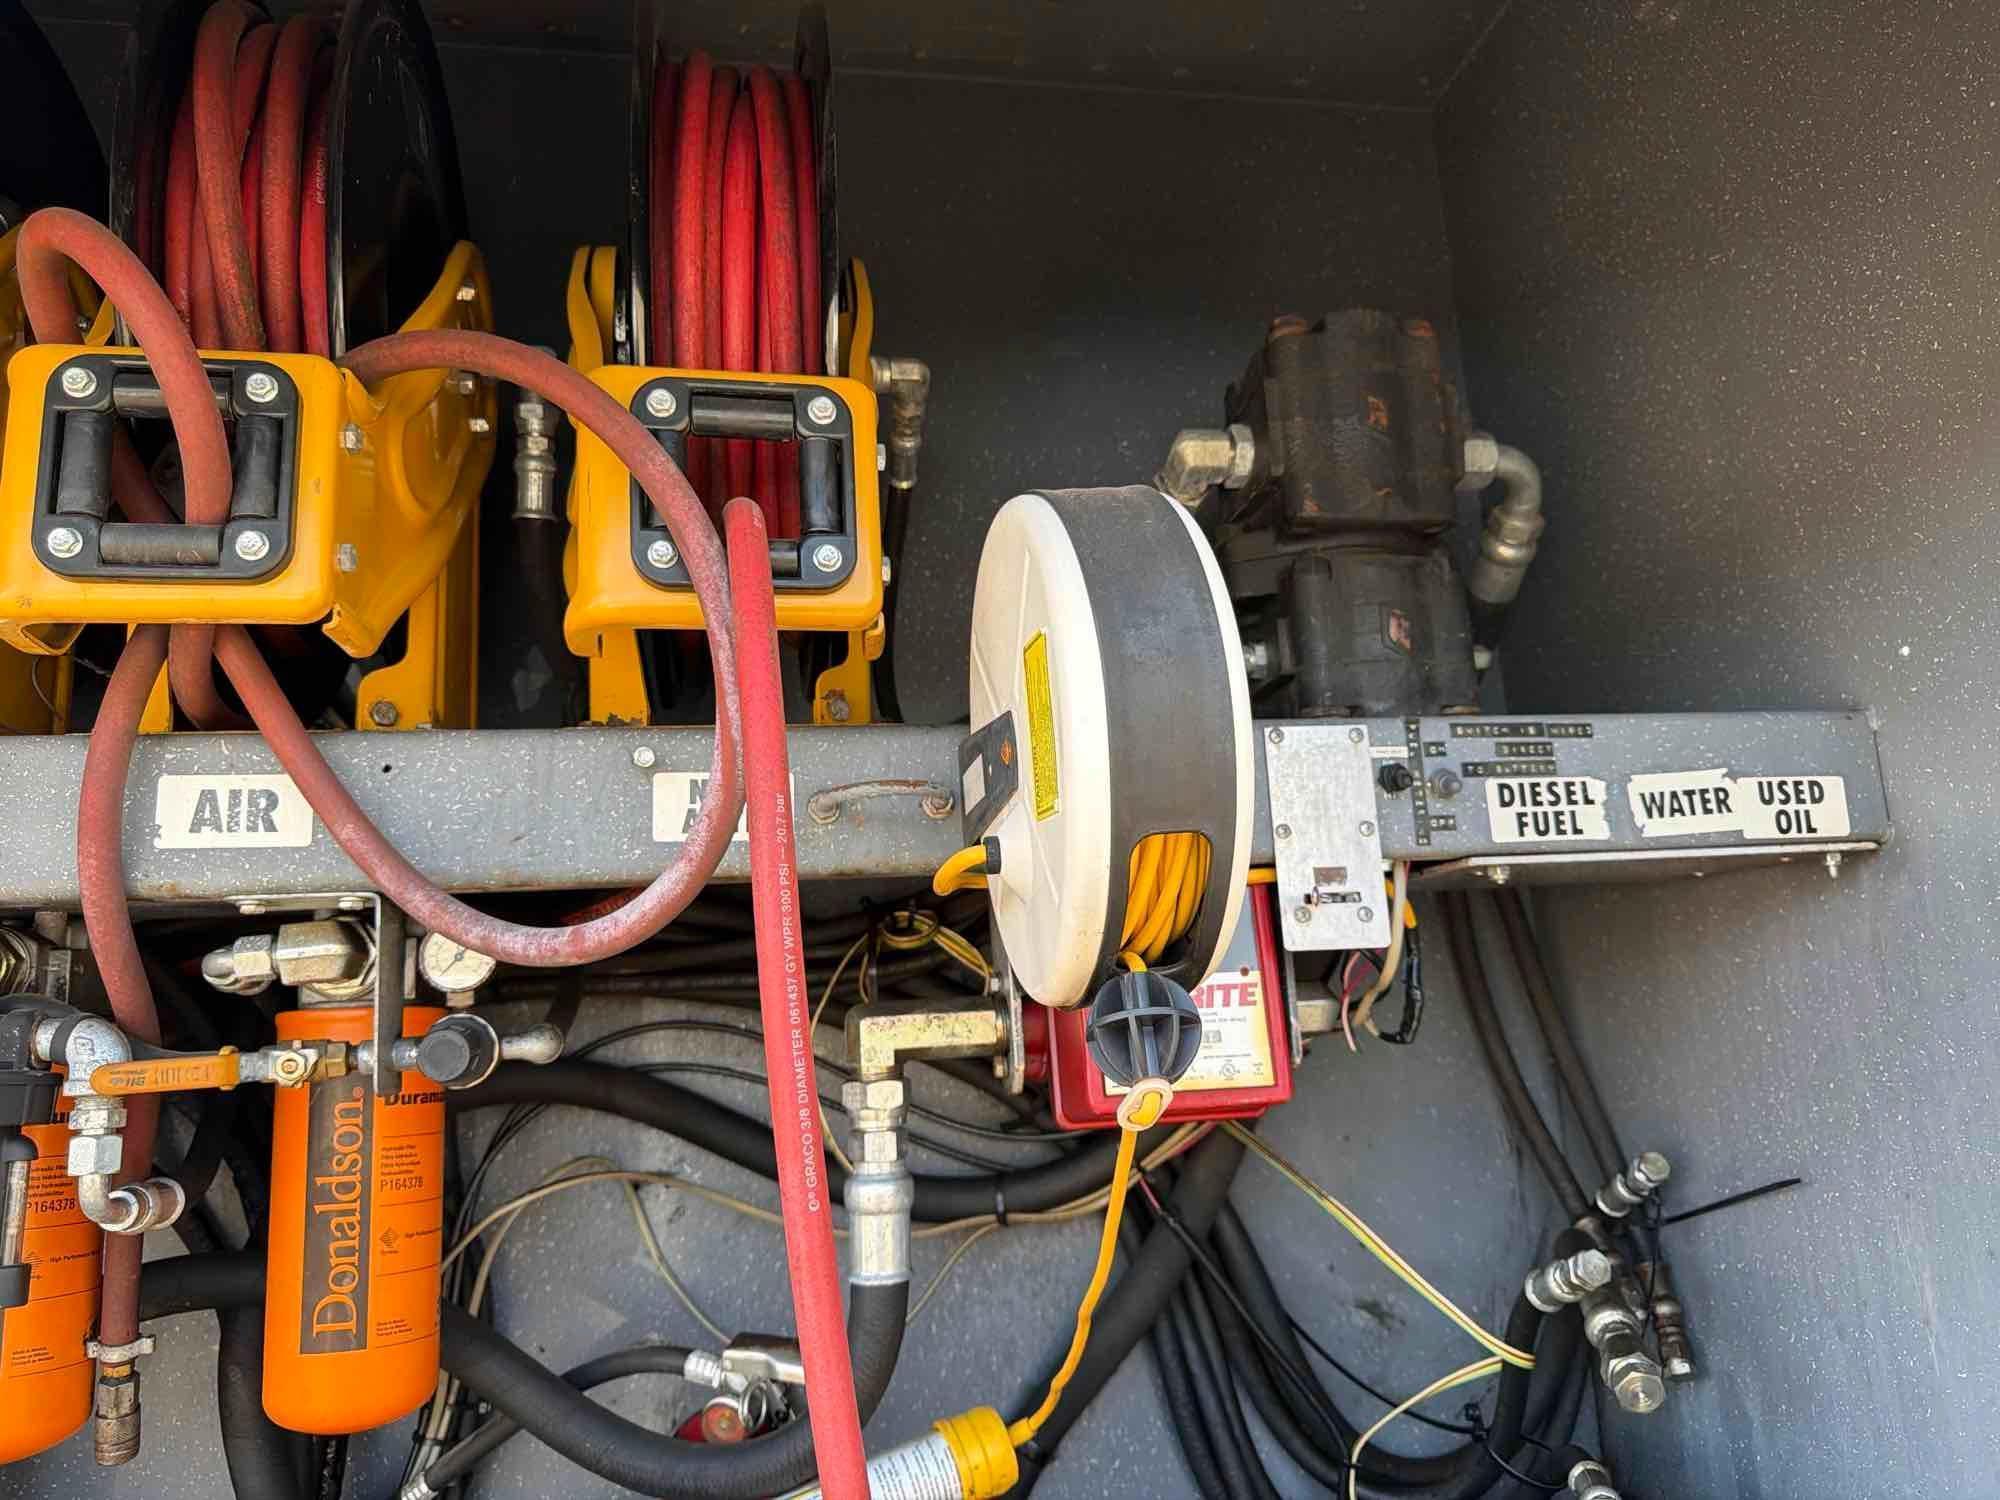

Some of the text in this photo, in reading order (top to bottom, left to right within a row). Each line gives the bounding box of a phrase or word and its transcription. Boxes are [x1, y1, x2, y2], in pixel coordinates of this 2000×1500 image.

[1466, 765, 1485, 775] TO
[775, 792, 785, 813] bar
[1497, 781, 1595, 808] DIESEL
[1639, 787, 1733, 819] WATER
[1757, 780, 1825, 805] USED
[189, 789, 279, 834] AIR
[1515, 810, 1584, 837] FUEL
[1775, 809, 1818, 835] OIL
[776, 817, 788, 844] 20.7
[778, 863, 791, 885] PSI
[779, 889, 793, 912] 300
[782, 916, 795, 949] WPR
[784, 953, 797, 974] GY
[791, 1028, 809, 1104] DIAMETER
[799, 1107, 812, 1129] 3/8
[800, 1133, 818, 1188] GRACO
